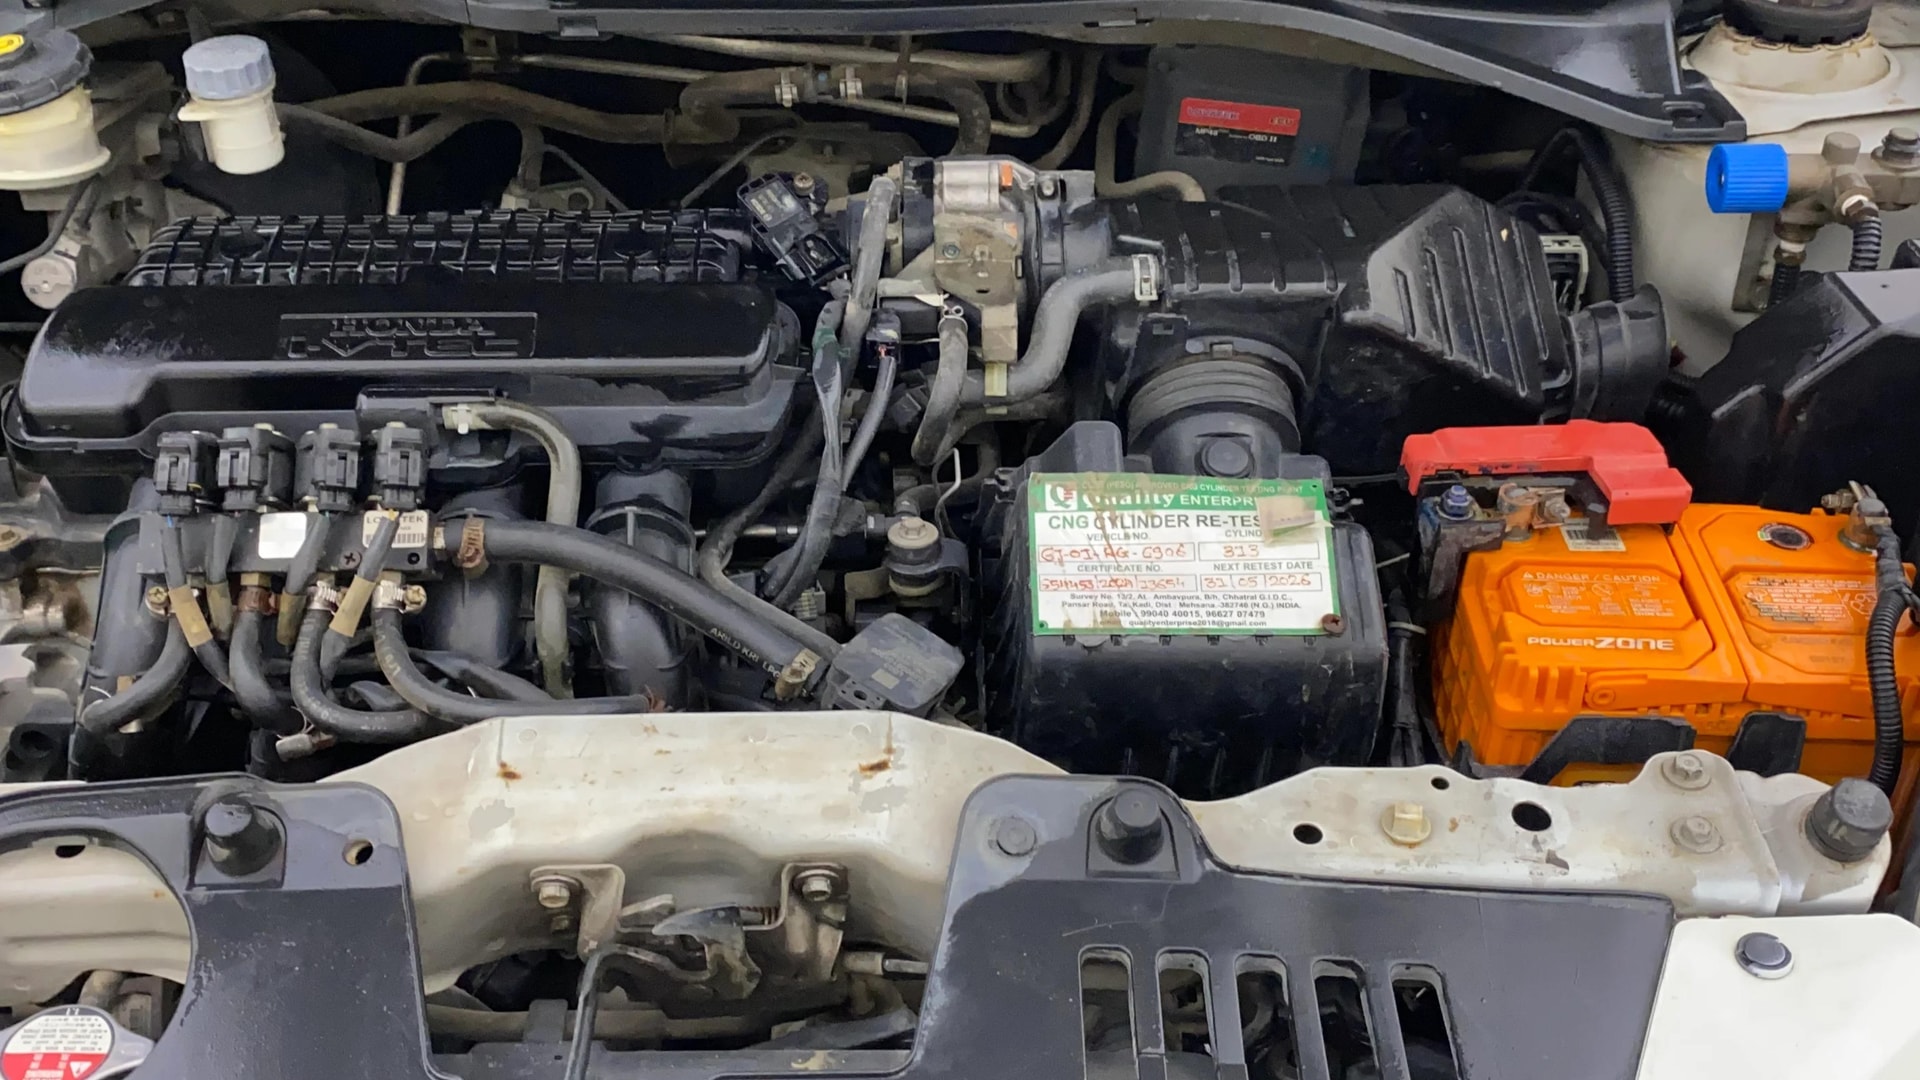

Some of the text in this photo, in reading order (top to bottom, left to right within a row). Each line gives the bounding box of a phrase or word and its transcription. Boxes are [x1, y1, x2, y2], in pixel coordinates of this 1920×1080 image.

[329, 318, 496, 336] HONDA
[1082, 489, 1174, 508] Quality
[1048, 514, 1260, 530] CNG CYLINDER RE-TES
[1087, 532, 1131, 541] VEHICLE
[1223, 544, 1260, 558] 313
[1077, 563, 1144, 573] CERTIFICATE
[1213, 560, 1313, 572] NEXT RETEST DATE
[1237, 575, 1258, 588] 05
[1536, 570, 1590, 582] DANGER
[1603, 573, 1661, 583] CAUTION
[1070, 593, 1098, 601] Survey
[1099, 610, 1132, 618] Mobile
[1140, 610, 1169, 618] 99040
[1205, 610, 1234, 618] 96627
